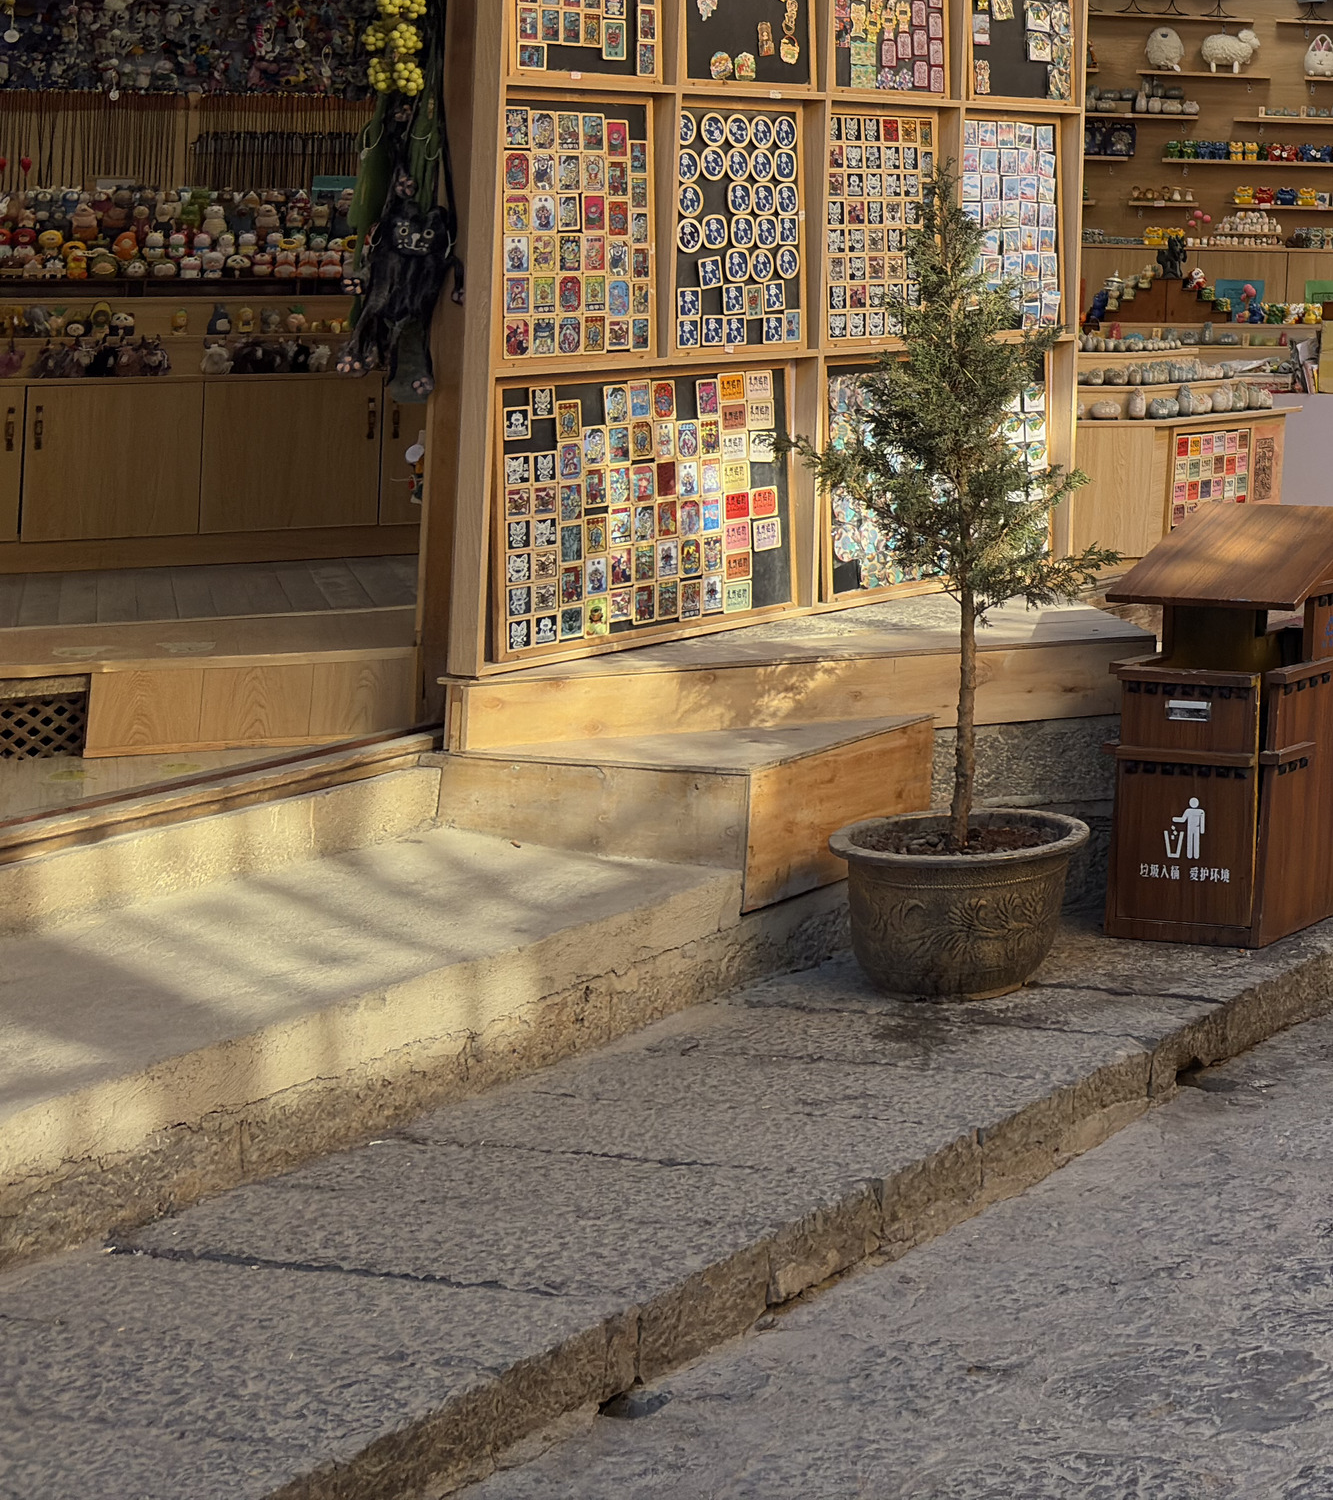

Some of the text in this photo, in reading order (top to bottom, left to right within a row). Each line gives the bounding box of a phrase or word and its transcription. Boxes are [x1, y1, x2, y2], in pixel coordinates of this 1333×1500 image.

[1140, 863, 1231, 883] 垃圾入桶 爱护环境
